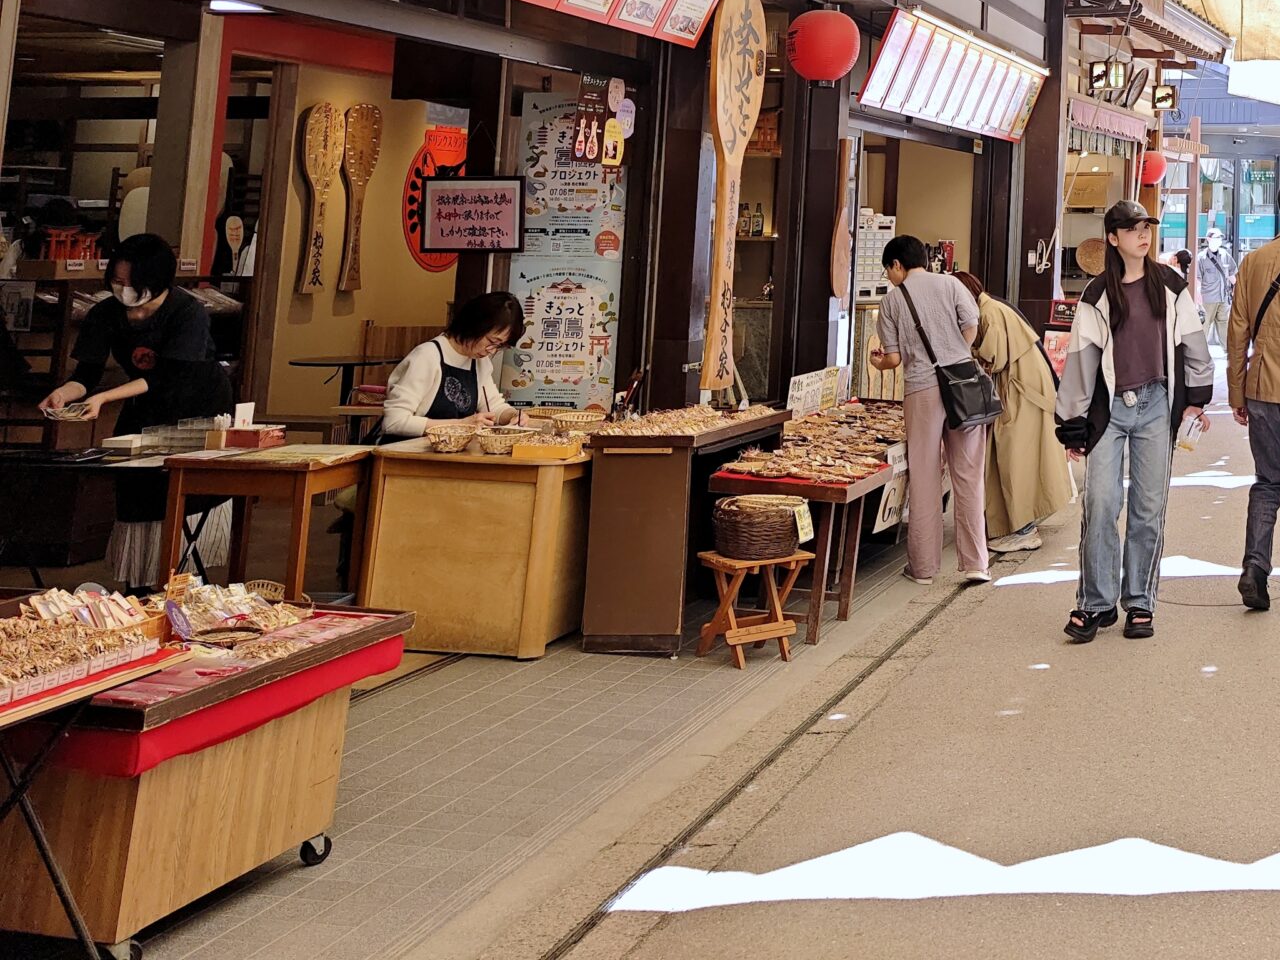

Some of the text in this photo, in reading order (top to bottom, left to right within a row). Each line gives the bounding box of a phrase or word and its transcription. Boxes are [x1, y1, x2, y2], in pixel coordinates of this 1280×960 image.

[551, 169, 599, 180] プロジェクト
[308, 230, 324, 286] 杓子の家
[545, 301, 585, 315] きらっと
[541, 317, 584, 339] 宮島
[715, 280, 732, 380] 杓子の家
[537, 341, 586, 352] プロジェクト
